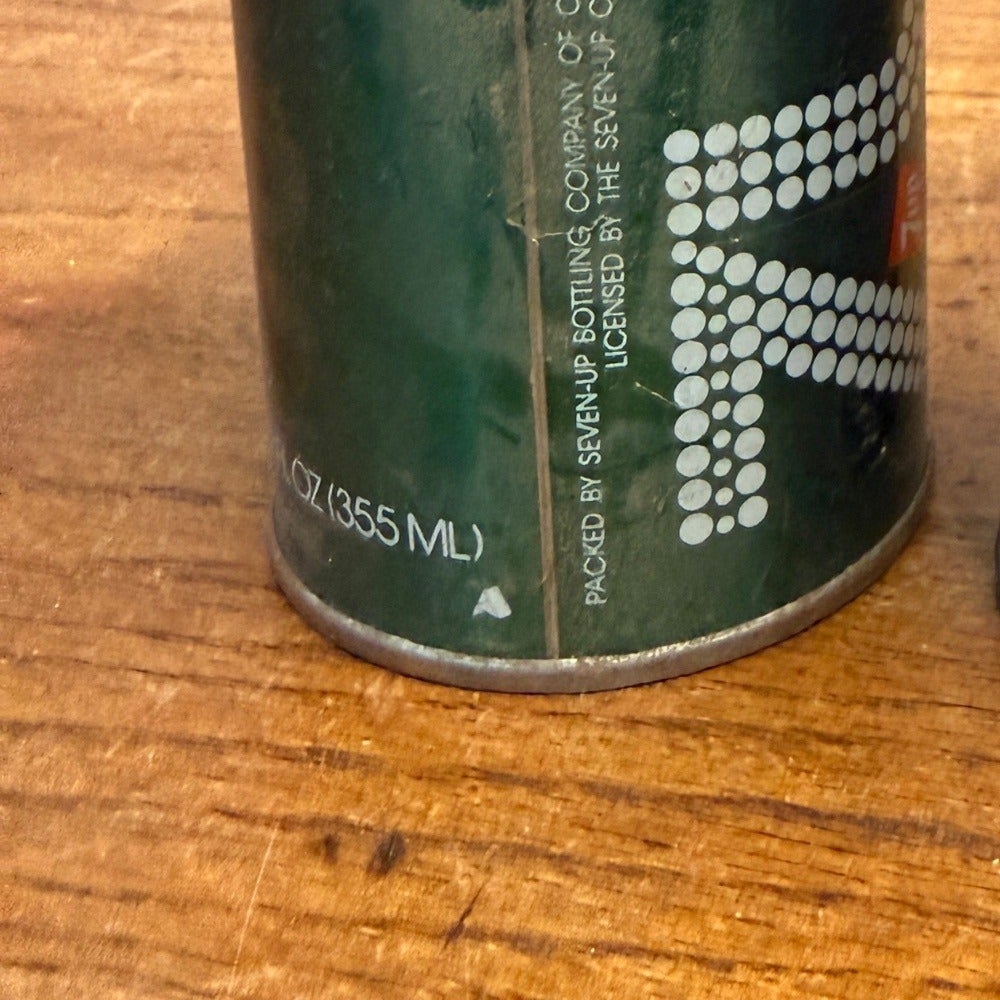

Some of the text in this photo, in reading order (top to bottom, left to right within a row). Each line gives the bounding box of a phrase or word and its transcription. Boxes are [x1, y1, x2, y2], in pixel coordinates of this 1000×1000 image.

[557, 28, 583, 65] OF
[590, 30, 619, 151] SEVEN-UP
[560, 77, 590, 213] COMPANY
[596, 161, 621, 205] THE
[599, 216, 624, 243] BY
[566, 226, 597, 344] BOTTLING
[601, 253, 628, 370] LICENSED
[574, 354, 602, 466] SEVEN-UP
[580, 474, 604, 504] BY
[406, 512, 484, 562] ML)
[572, 513, 608, 607] PACKED
